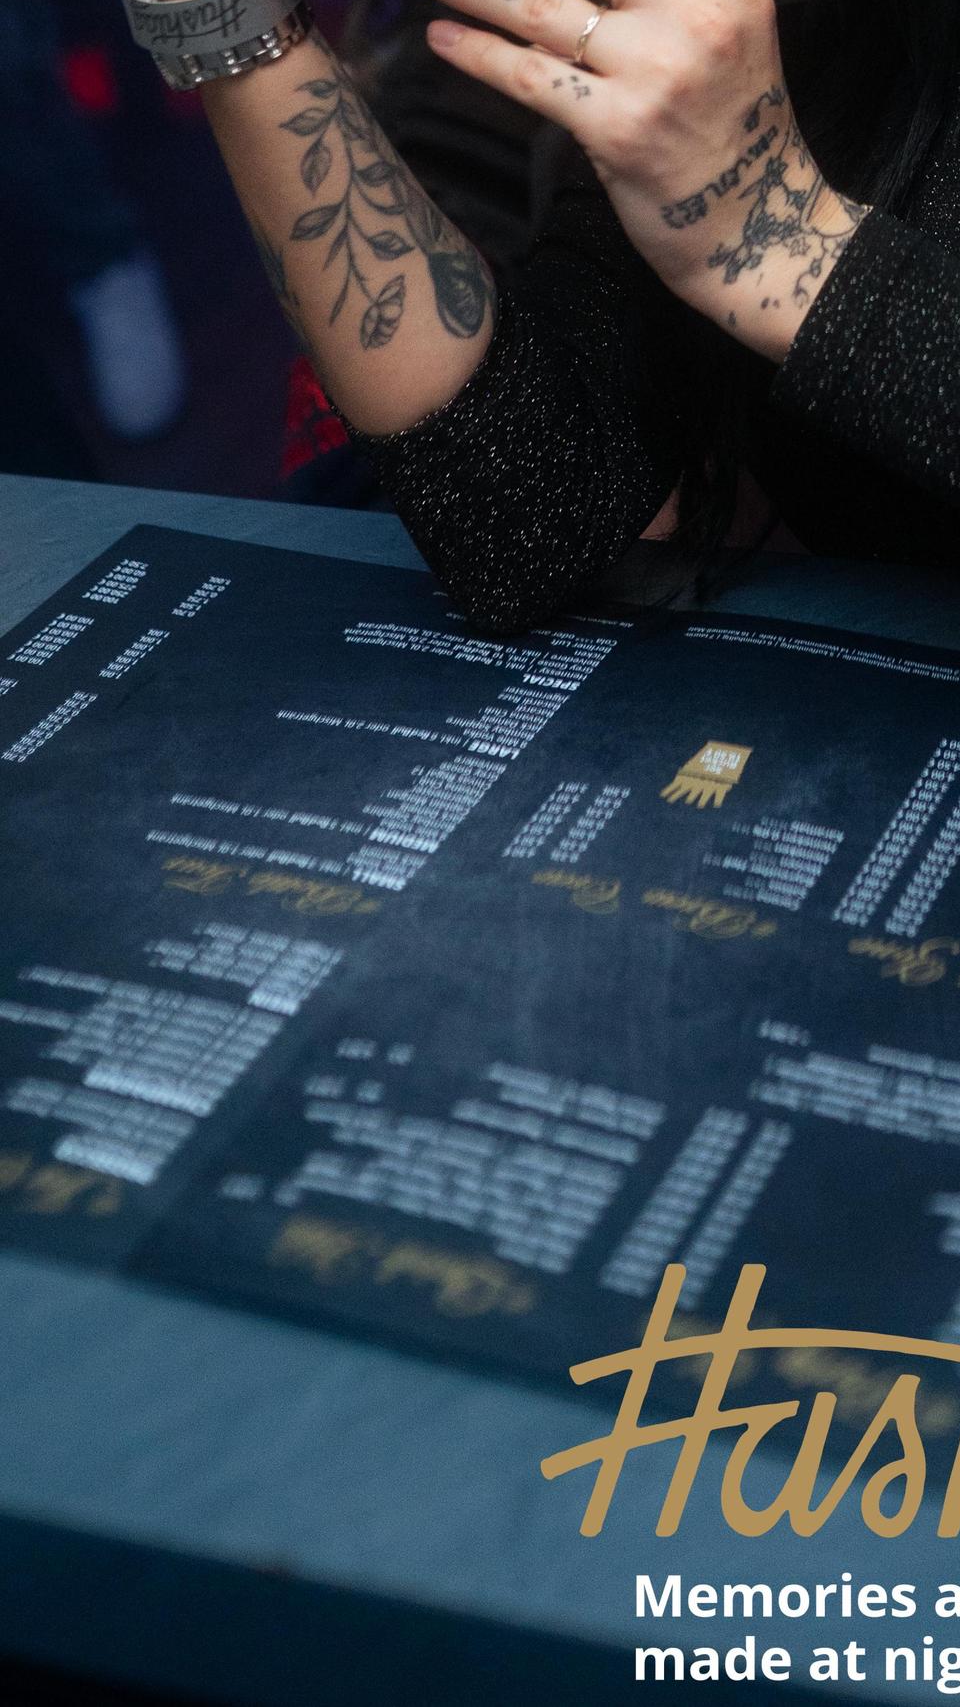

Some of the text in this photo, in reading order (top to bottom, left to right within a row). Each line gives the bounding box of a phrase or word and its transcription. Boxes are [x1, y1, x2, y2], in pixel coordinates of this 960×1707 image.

[523, 673, 579, 690] SPECIAL
[468, 740, 522, 759] LARGE
[369, 828, 444, 853] MEDIUM
